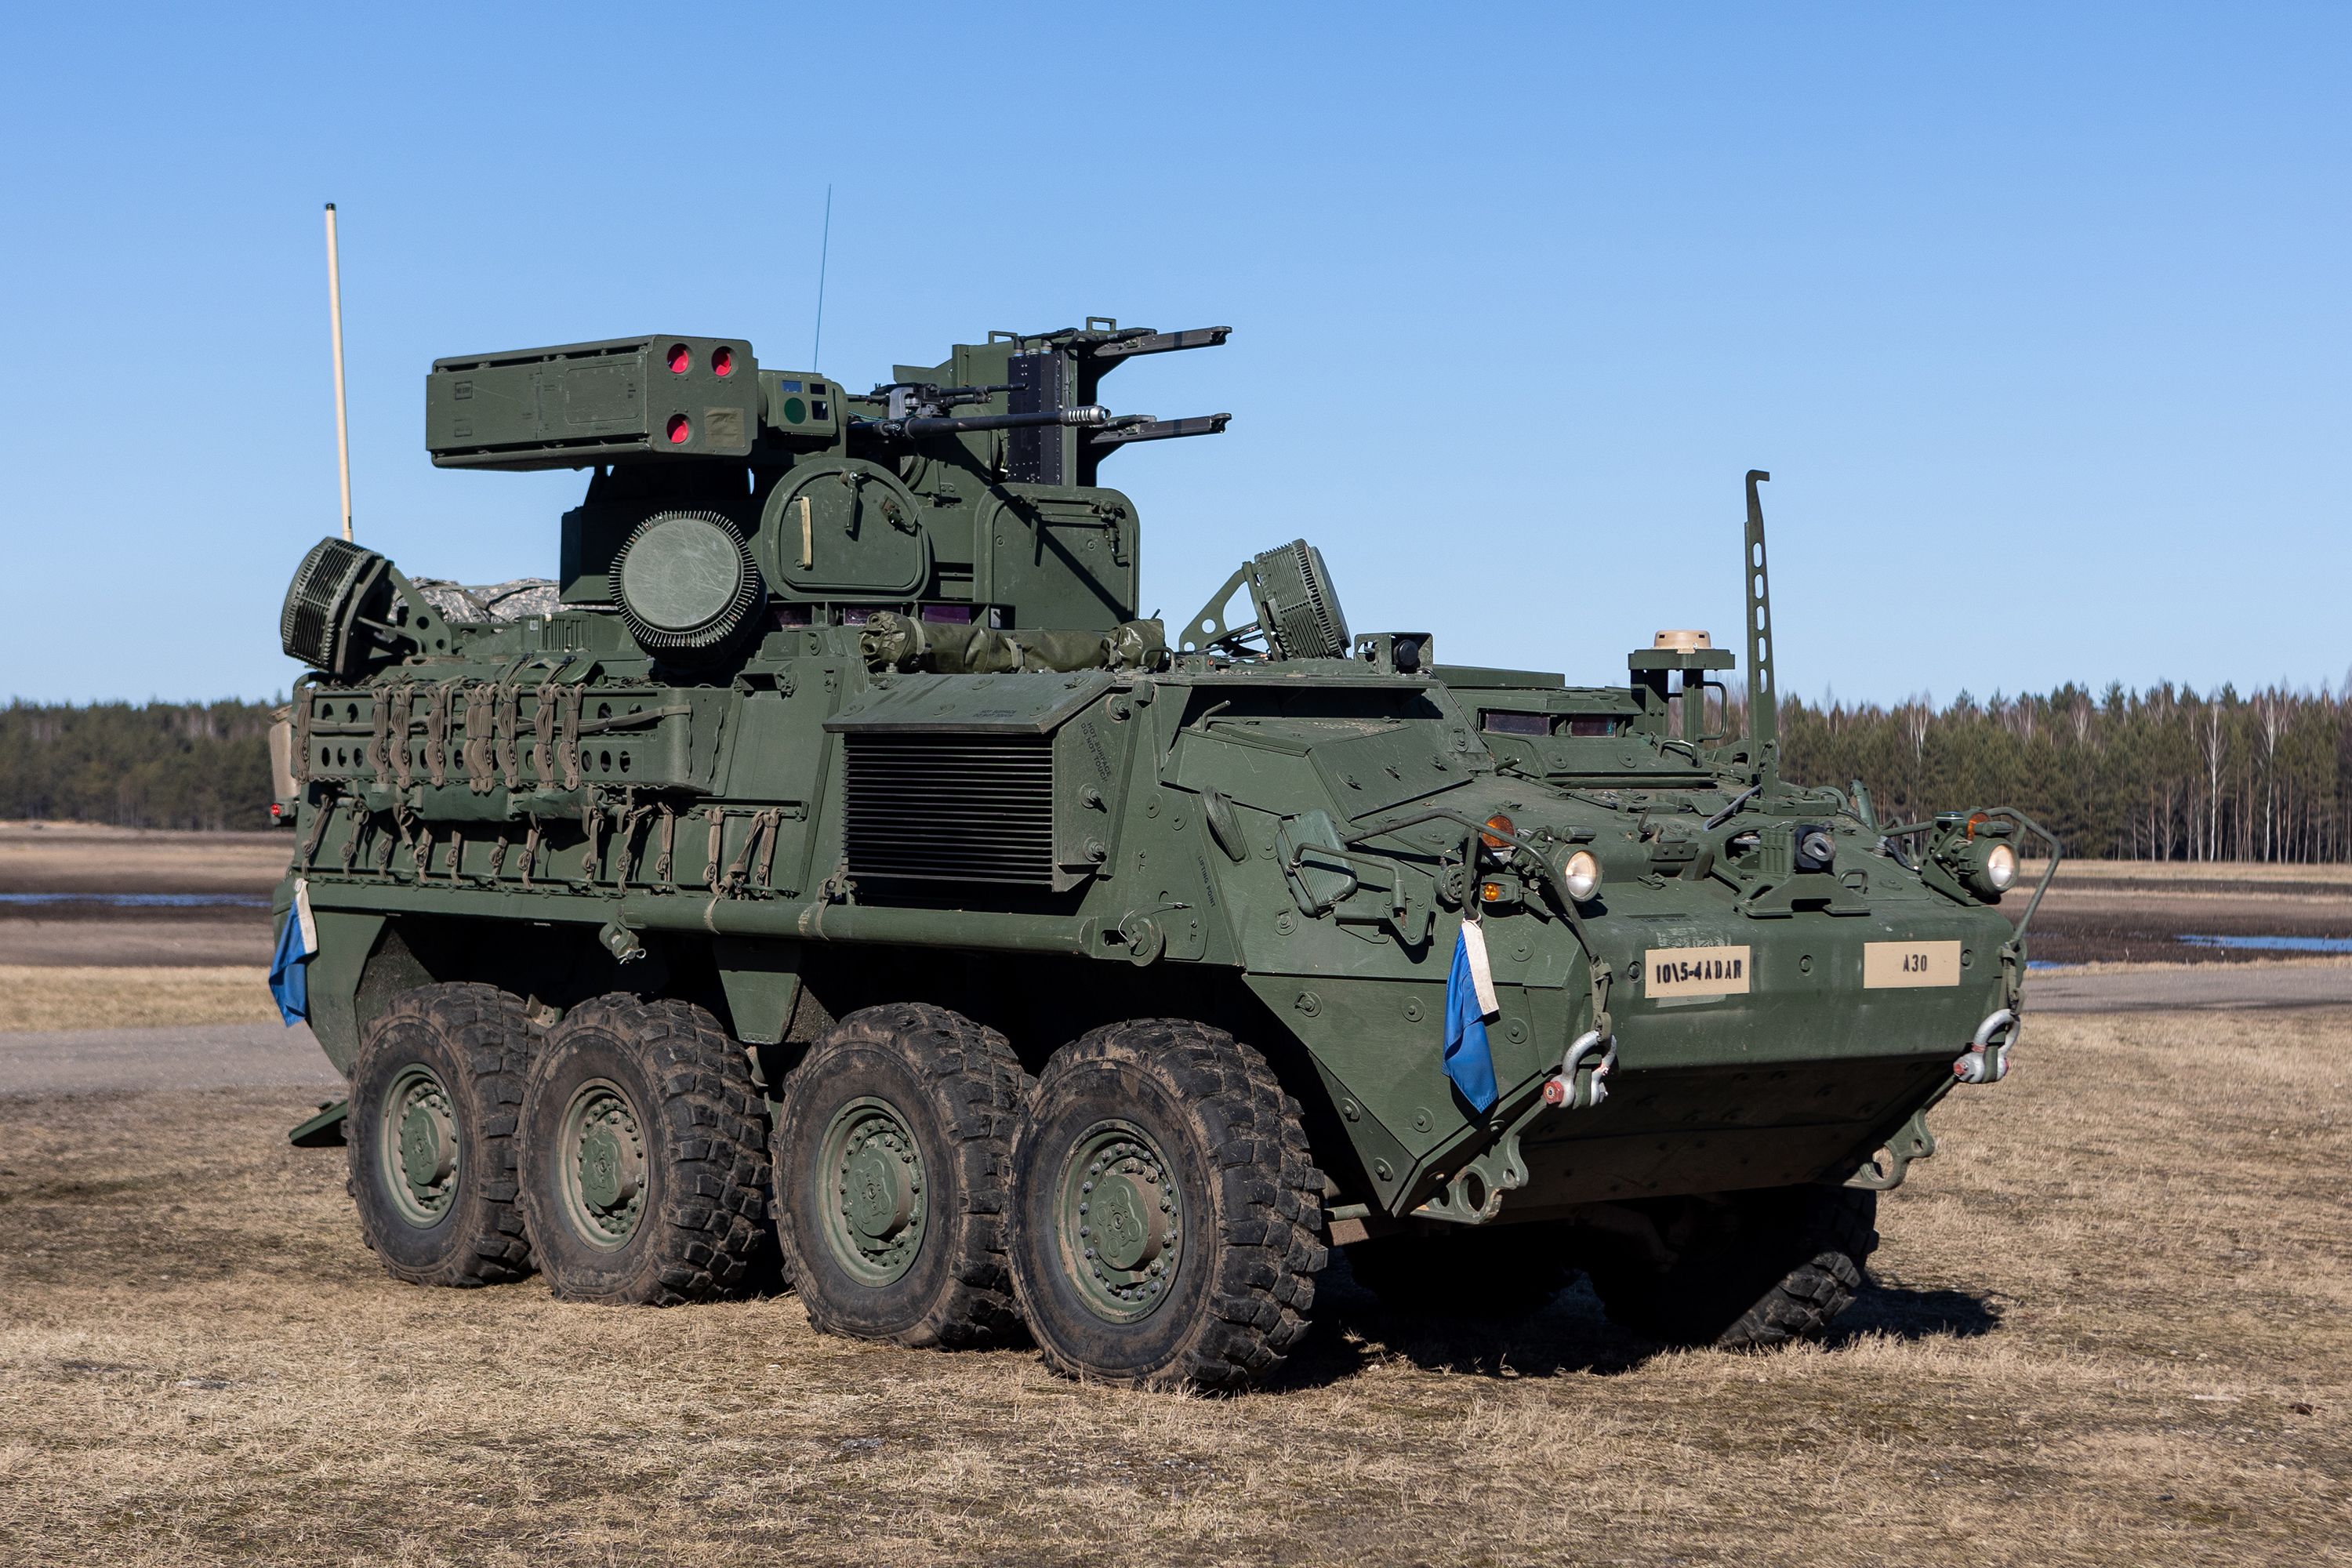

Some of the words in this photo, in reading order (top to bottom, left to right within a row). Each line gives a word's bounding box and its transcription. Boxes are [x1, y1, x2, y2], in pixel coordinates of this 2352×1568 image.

[1080, 722, 1089, 735] DO
[1087, 737, 1096, 753] NOT
[1087, 721, 1097, 739] HOT
[1094, 741, 1112, 778] SURFACE
[1198, 855, 1209, 884] LIFTING
[1207, 885, 1216, 908] POINT
[1903, 953, 1927, 972] A30
